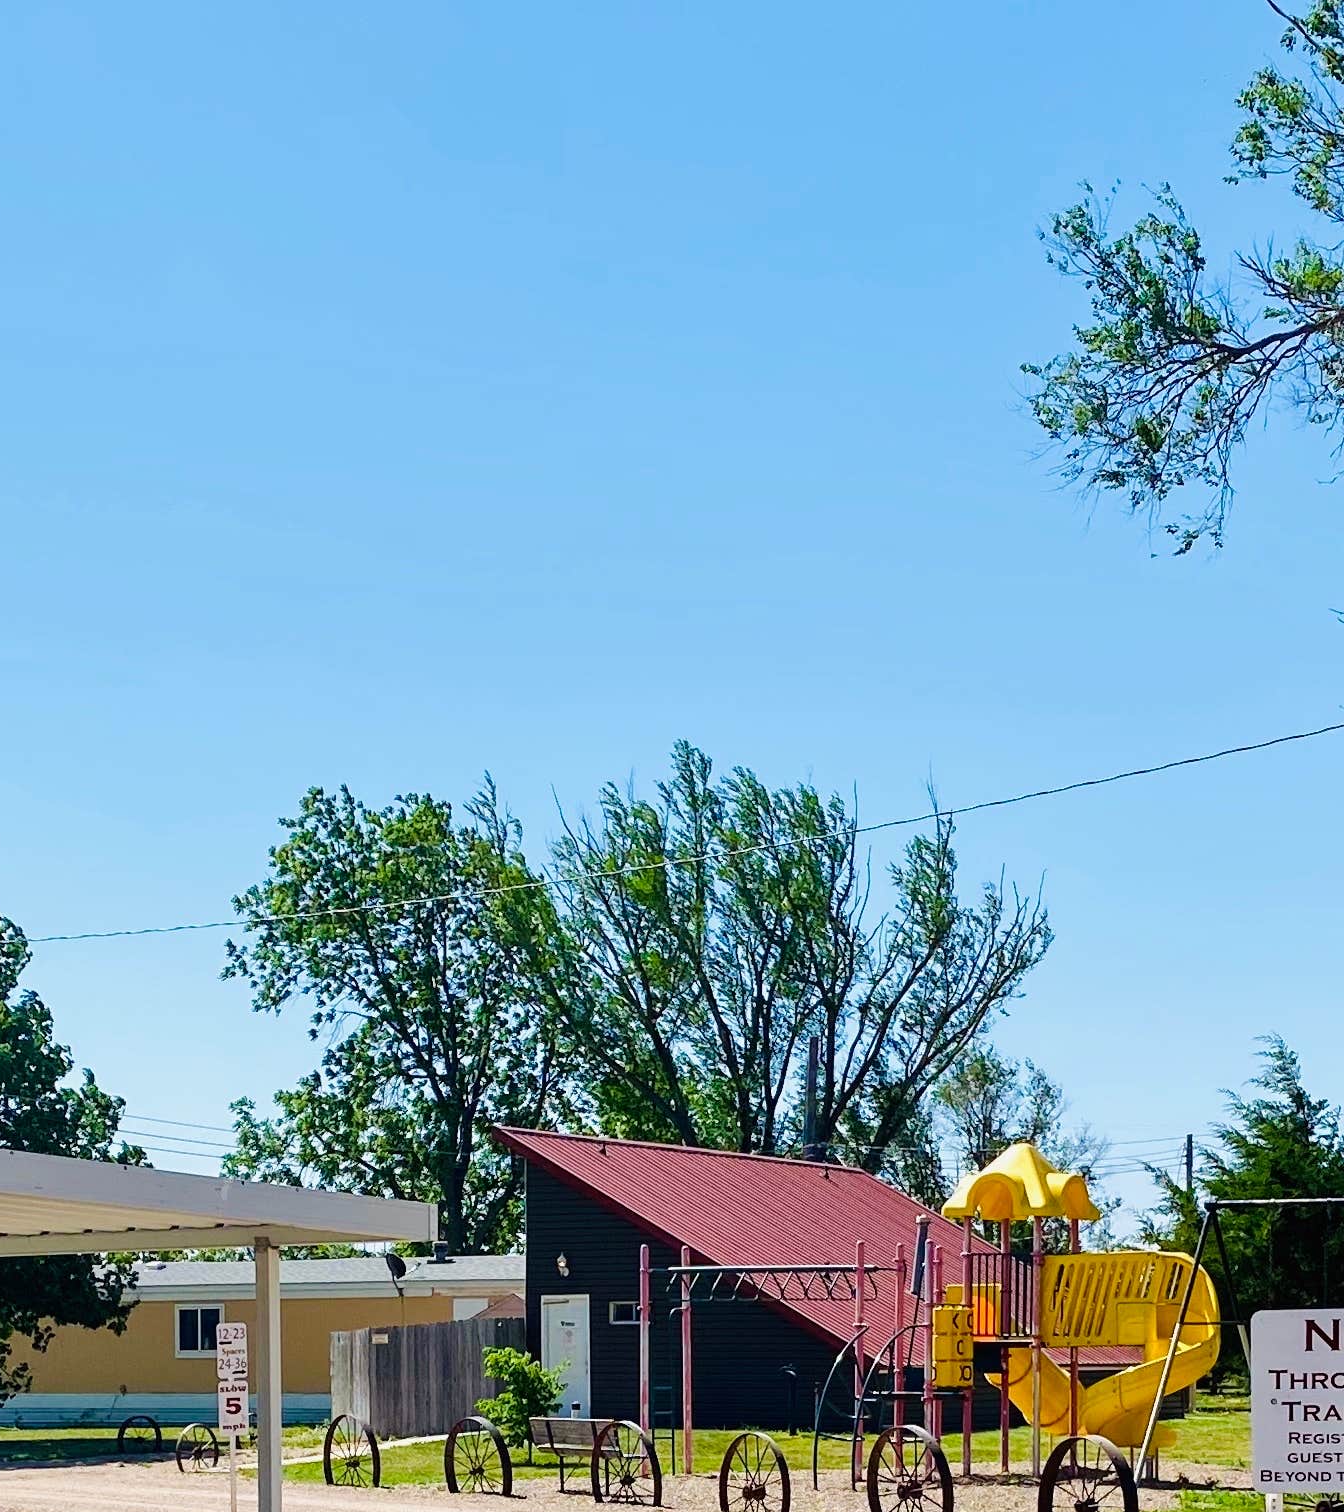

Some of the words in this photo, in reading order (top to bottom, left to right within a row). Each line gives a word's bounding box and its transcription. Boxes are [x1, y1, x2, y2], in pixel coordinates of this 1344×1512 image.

[222, 1348, 245, 1357] Spaces
[218, 1358, 247, 1370] 24-36
[219, 1385, 247, 1393] SLOW
[225, 1397, 242, 1415] 5
[222, 1423, 246, 1431] mph
[1260, 1470, 1332, 1482] BEYOND
